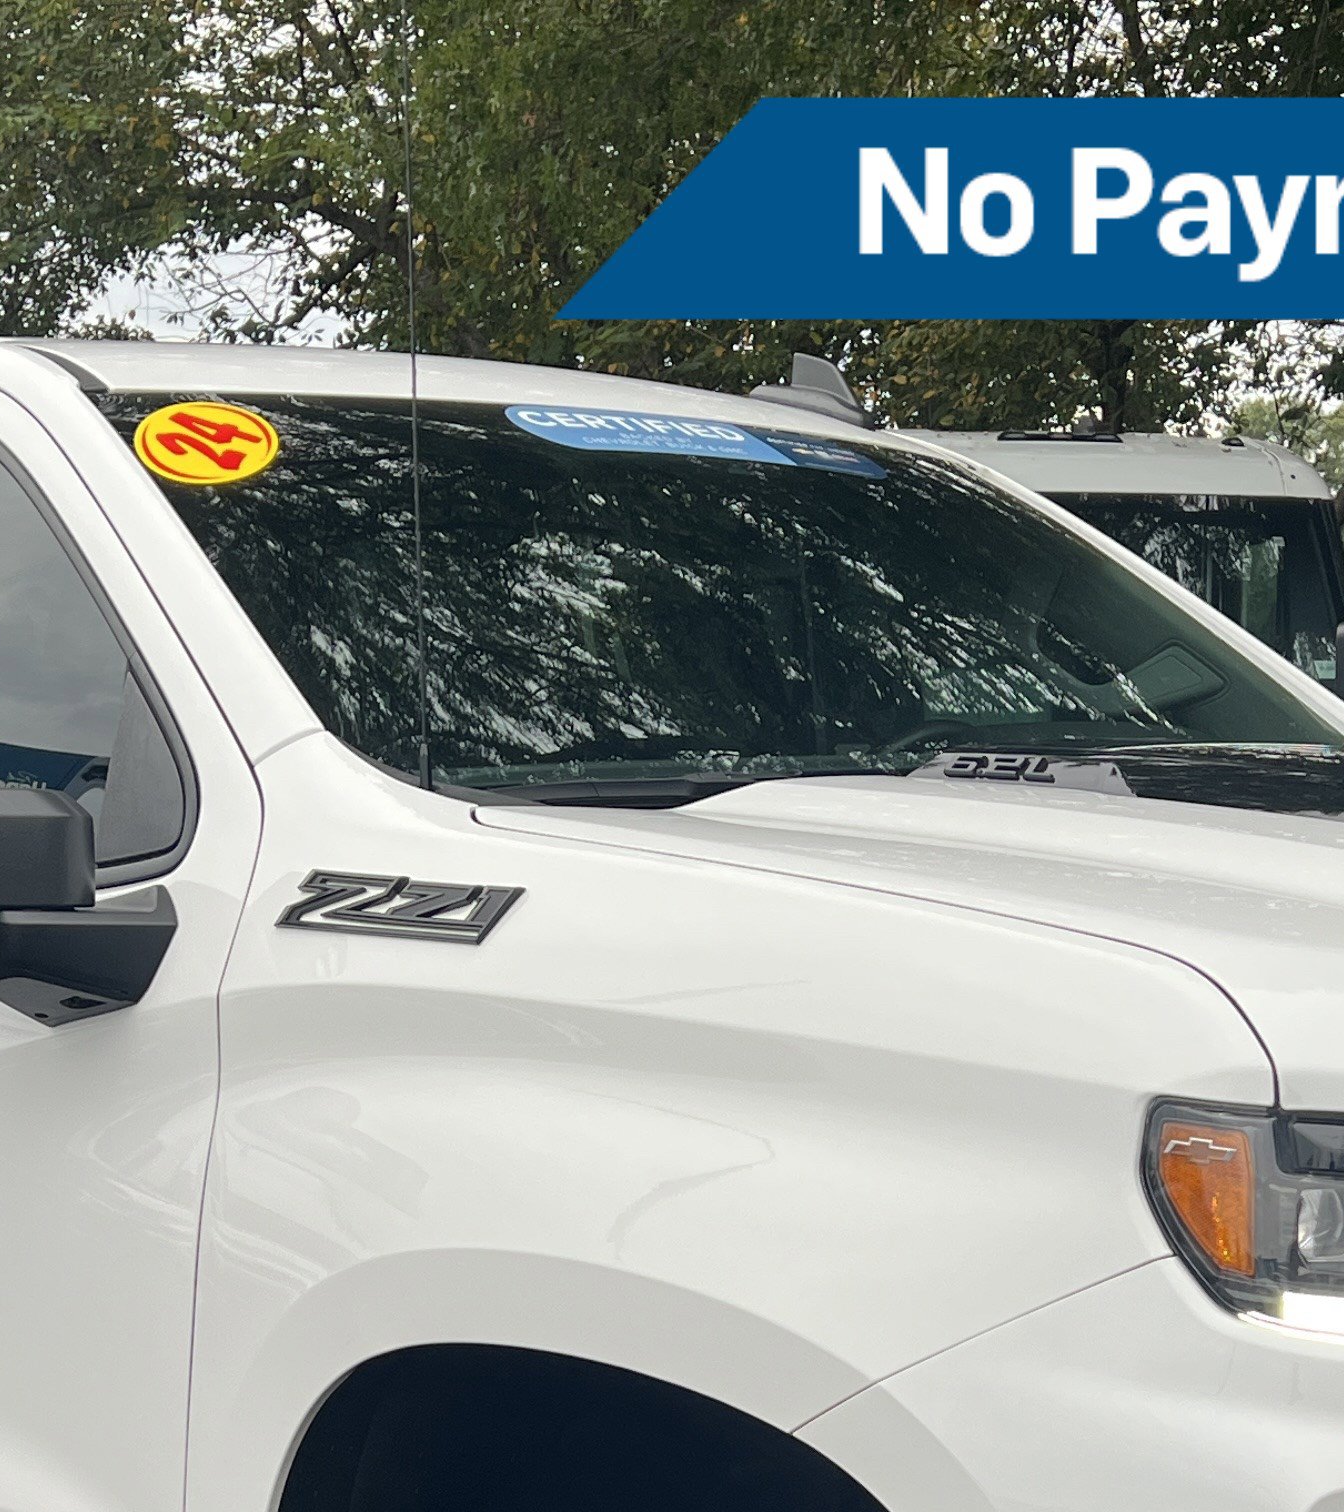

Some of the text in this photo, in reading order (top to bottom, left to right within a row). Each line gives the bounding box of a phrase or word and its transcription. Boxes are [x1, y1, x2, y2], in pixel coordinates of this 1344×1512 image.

[155, 412, 262, 470] 24
[517, 410, 745, 442] CERTIFIED
[273, 868, 519, 946] Z71
